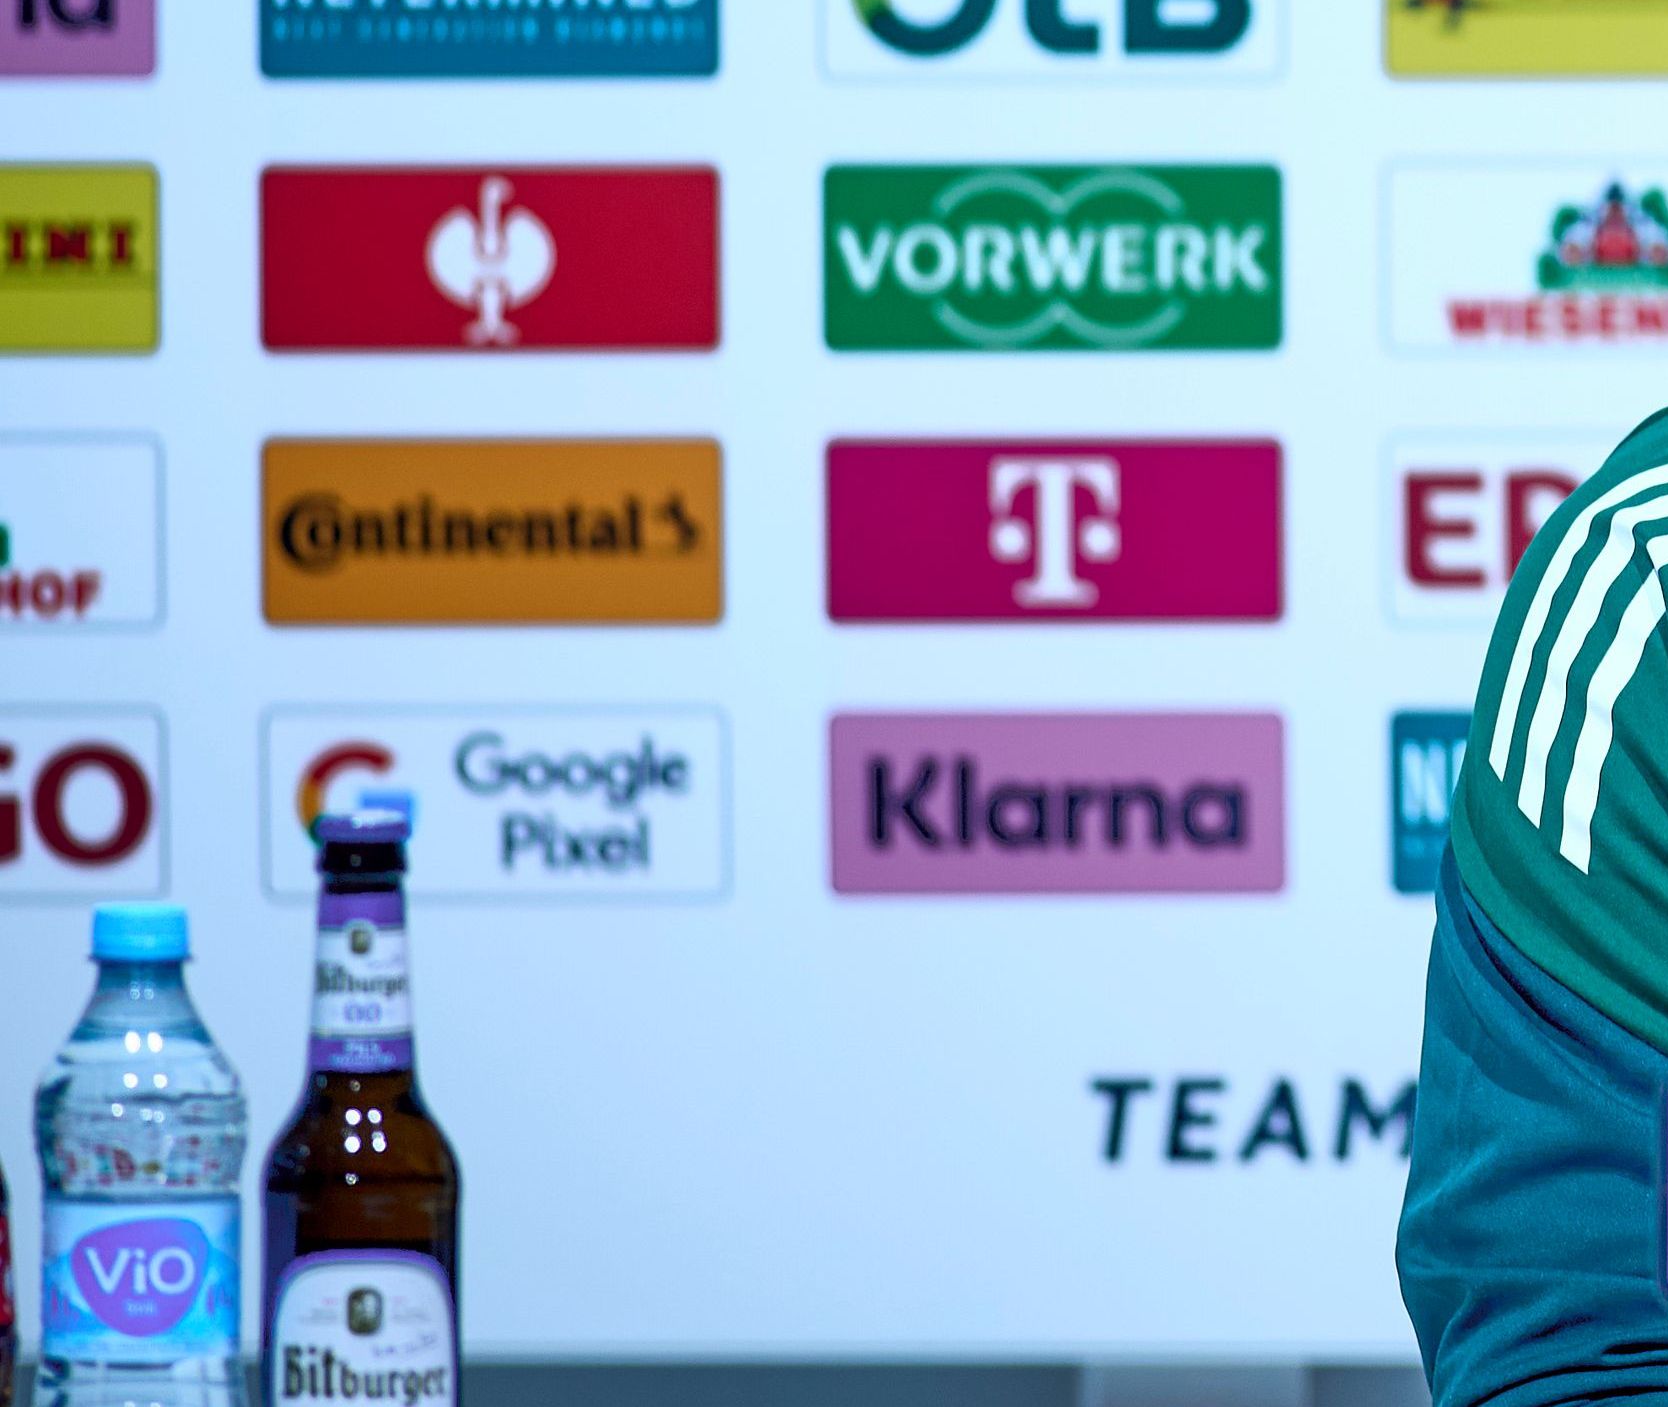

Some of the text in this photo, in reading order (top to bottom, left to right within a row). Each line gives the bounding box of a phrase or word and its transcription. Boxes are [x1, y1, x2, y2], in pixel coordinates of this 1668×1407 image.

[836, 222, 1270, 295] VORWERK
[279, 490, 644, 575] Continental
[451, 729, 694, 807] Google
[864, 749, 1252, 854] Klarna
[498, 812, 653, 874] Pixel
[1088, 1076, 1418, 1163] TEAM
[283, 1344, 447, 1407] Bitburger
